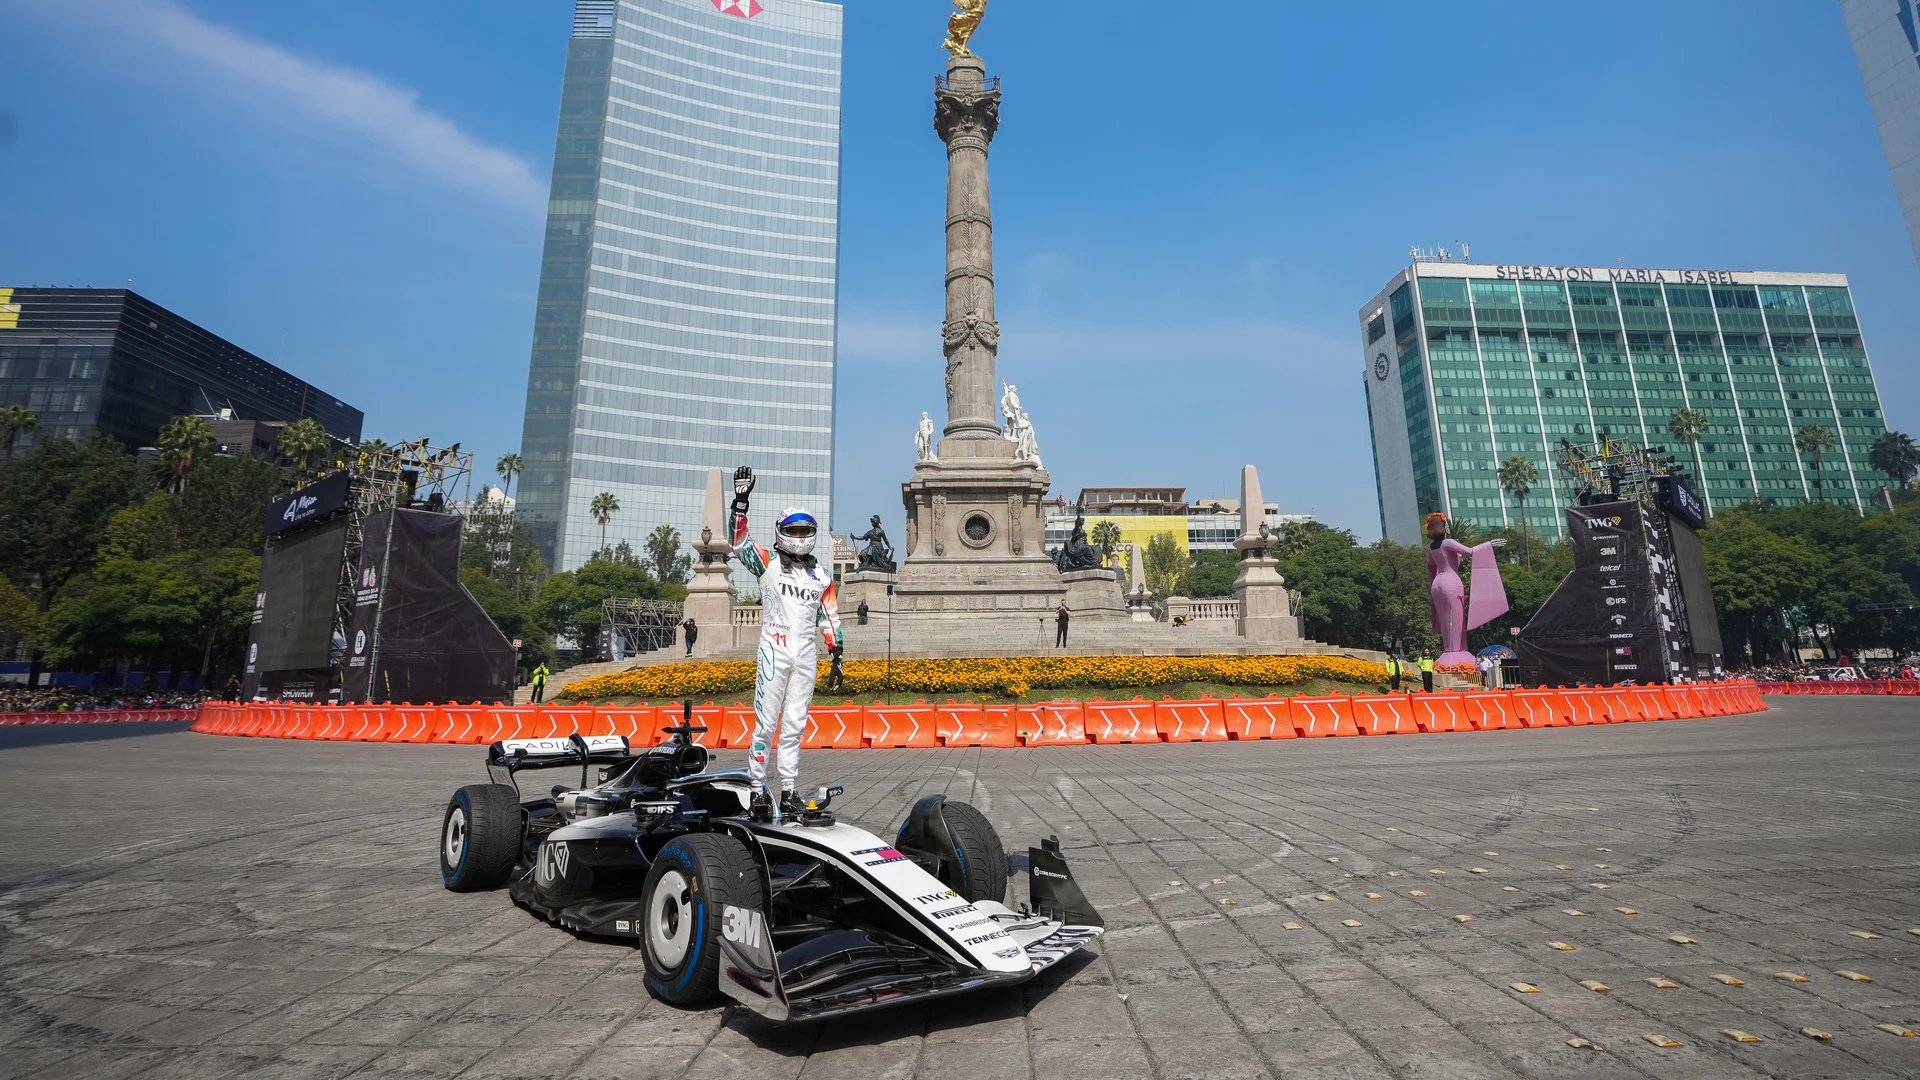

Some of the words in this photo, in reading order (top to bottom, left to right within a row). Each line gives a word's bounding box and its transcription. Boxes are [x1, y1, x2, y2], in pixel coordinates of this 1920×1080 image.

[1496, 265, 1593, 281] SHERATON
[1608, 268, 1666, 283] MARIA
[1679, 269, 1739, 285] ISABEL
[1585, 517, 1612, 529] TWG
[1600, 547, 1616, 556] 3M
[1600, 564, 1622, 572] telcel
[778, 582, 811, 601] TWG
[1615, 597, 1627, 605] IFS
[776, 623, 791, 631] CHECO
[507, 738, 619, 751] CADILAC
[657, 804, 675, 814] IFS
[853, 846, 892, 855] TOMMY
[867, 856, 907, 866] HILFIGER
[913, 891, 949, 905] TWG
[931, 904, 978, 919] PIRELLI
[722, 905, 761, 949] 3M
[963, 930, 1010, 946] TENNECO
